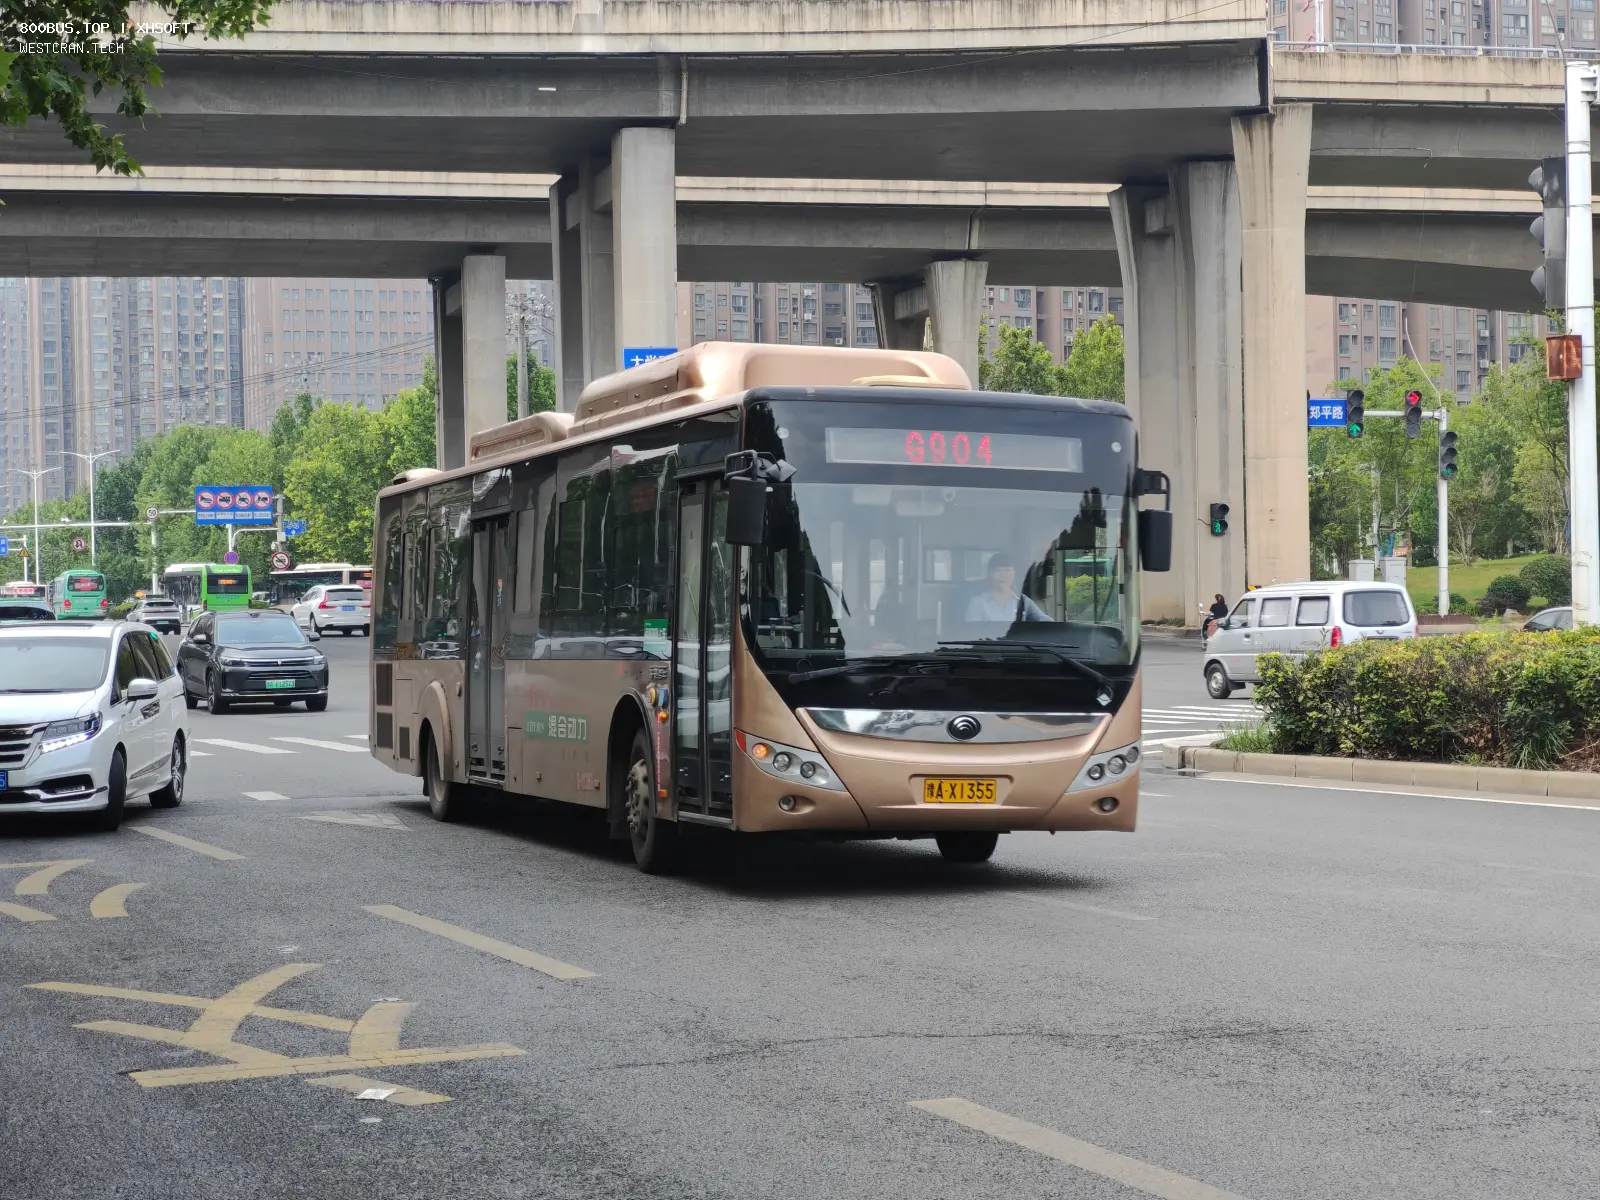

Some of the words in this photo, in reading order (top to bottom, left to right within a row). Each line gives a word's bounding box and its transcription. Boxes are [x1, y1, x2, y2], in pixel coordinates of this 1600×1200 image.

[1309, 405, 1343, 419] 郑平路
[905, 431, 992, 466] G904
